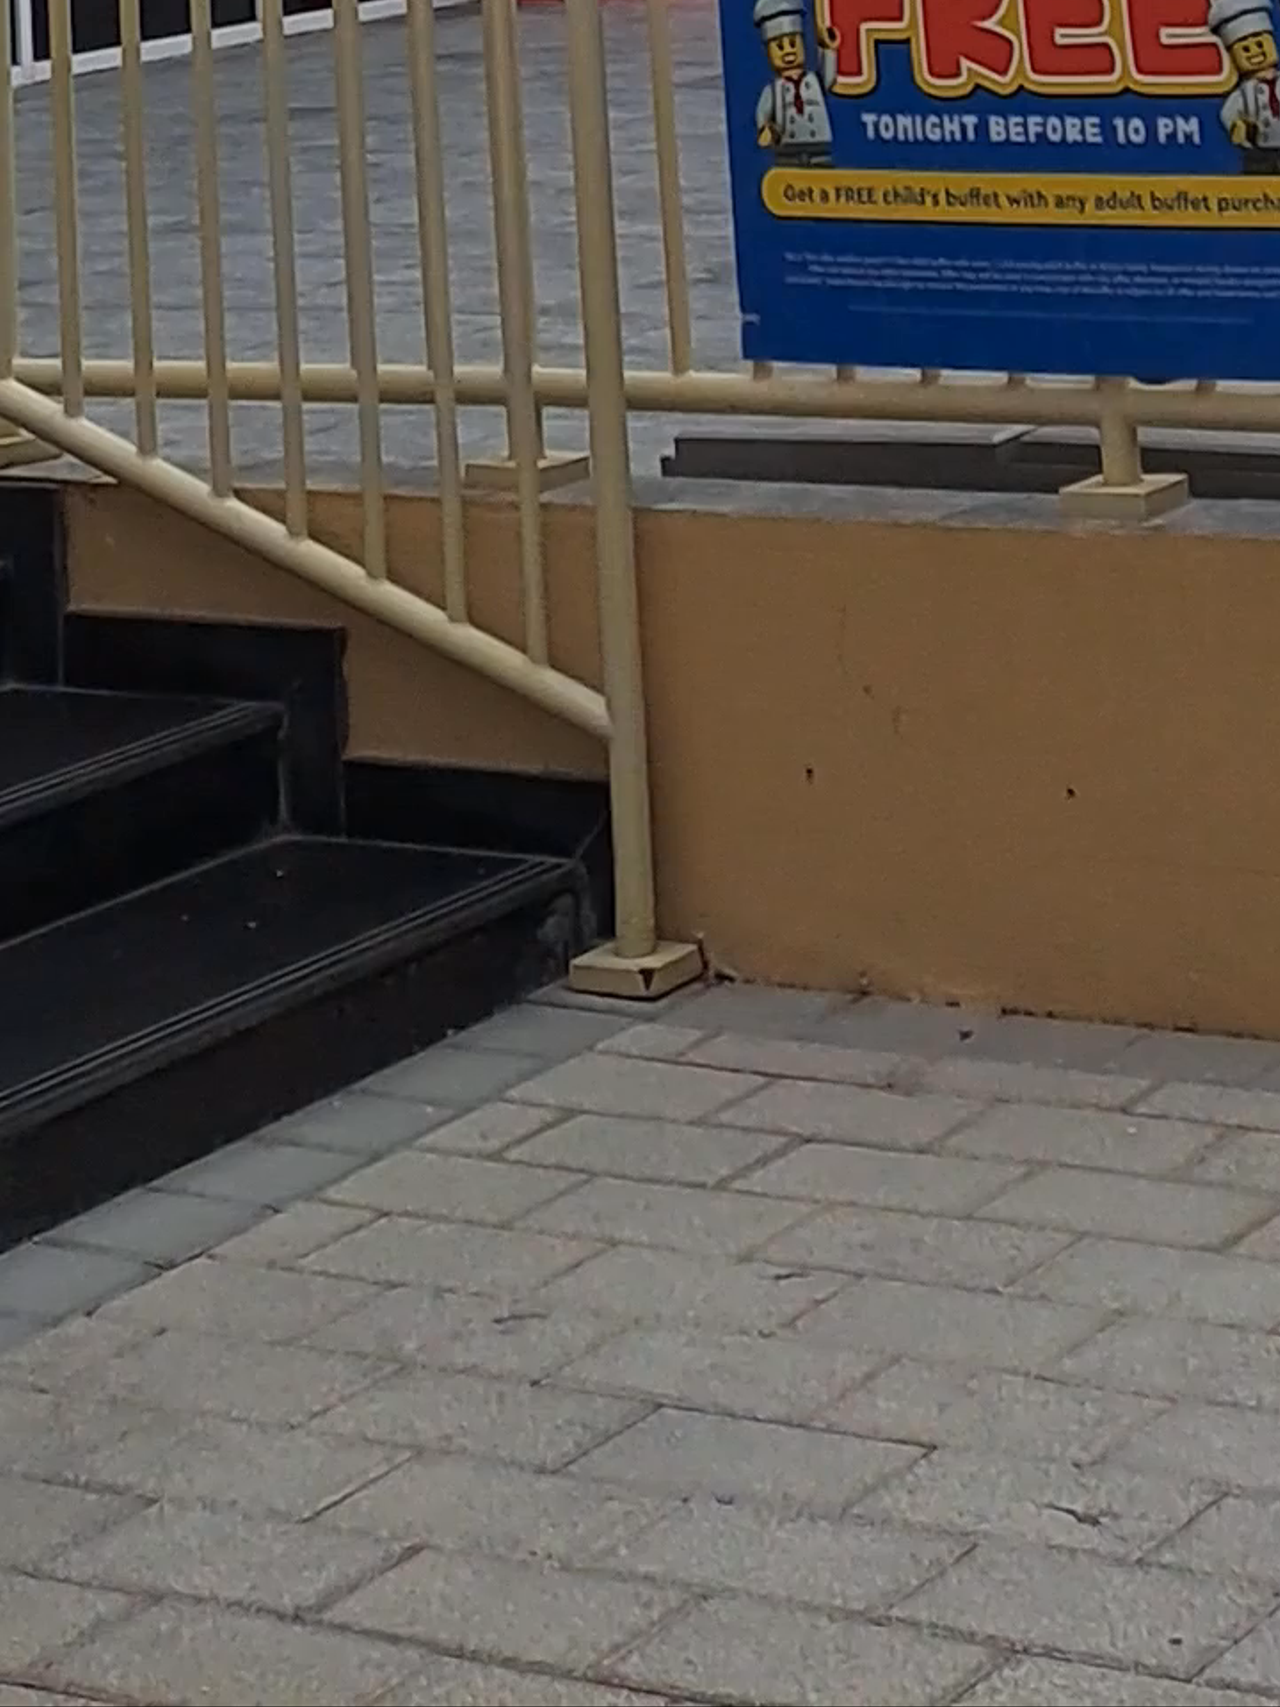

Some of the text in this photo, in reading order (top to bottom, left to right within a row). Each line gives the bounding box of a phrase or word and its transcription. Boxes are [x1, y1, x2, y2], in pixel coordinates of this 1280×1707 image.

[860, 112, 1202, 146] TONIGHT BEFORE 10 PM
[782, 183, 815, 204] Get
[819, 189, 830, 205] a
[834, 186, 878, 206] FREE
[882, 184, 940, 208] child's
[945, 186, 1002, 209] buffet
[1006, 189, 1049, 209] with
[1053, 193, 1089, 213] any
[1094, 190, 1146, 212] adult
[1149, 190, 1212, 213] buffet
